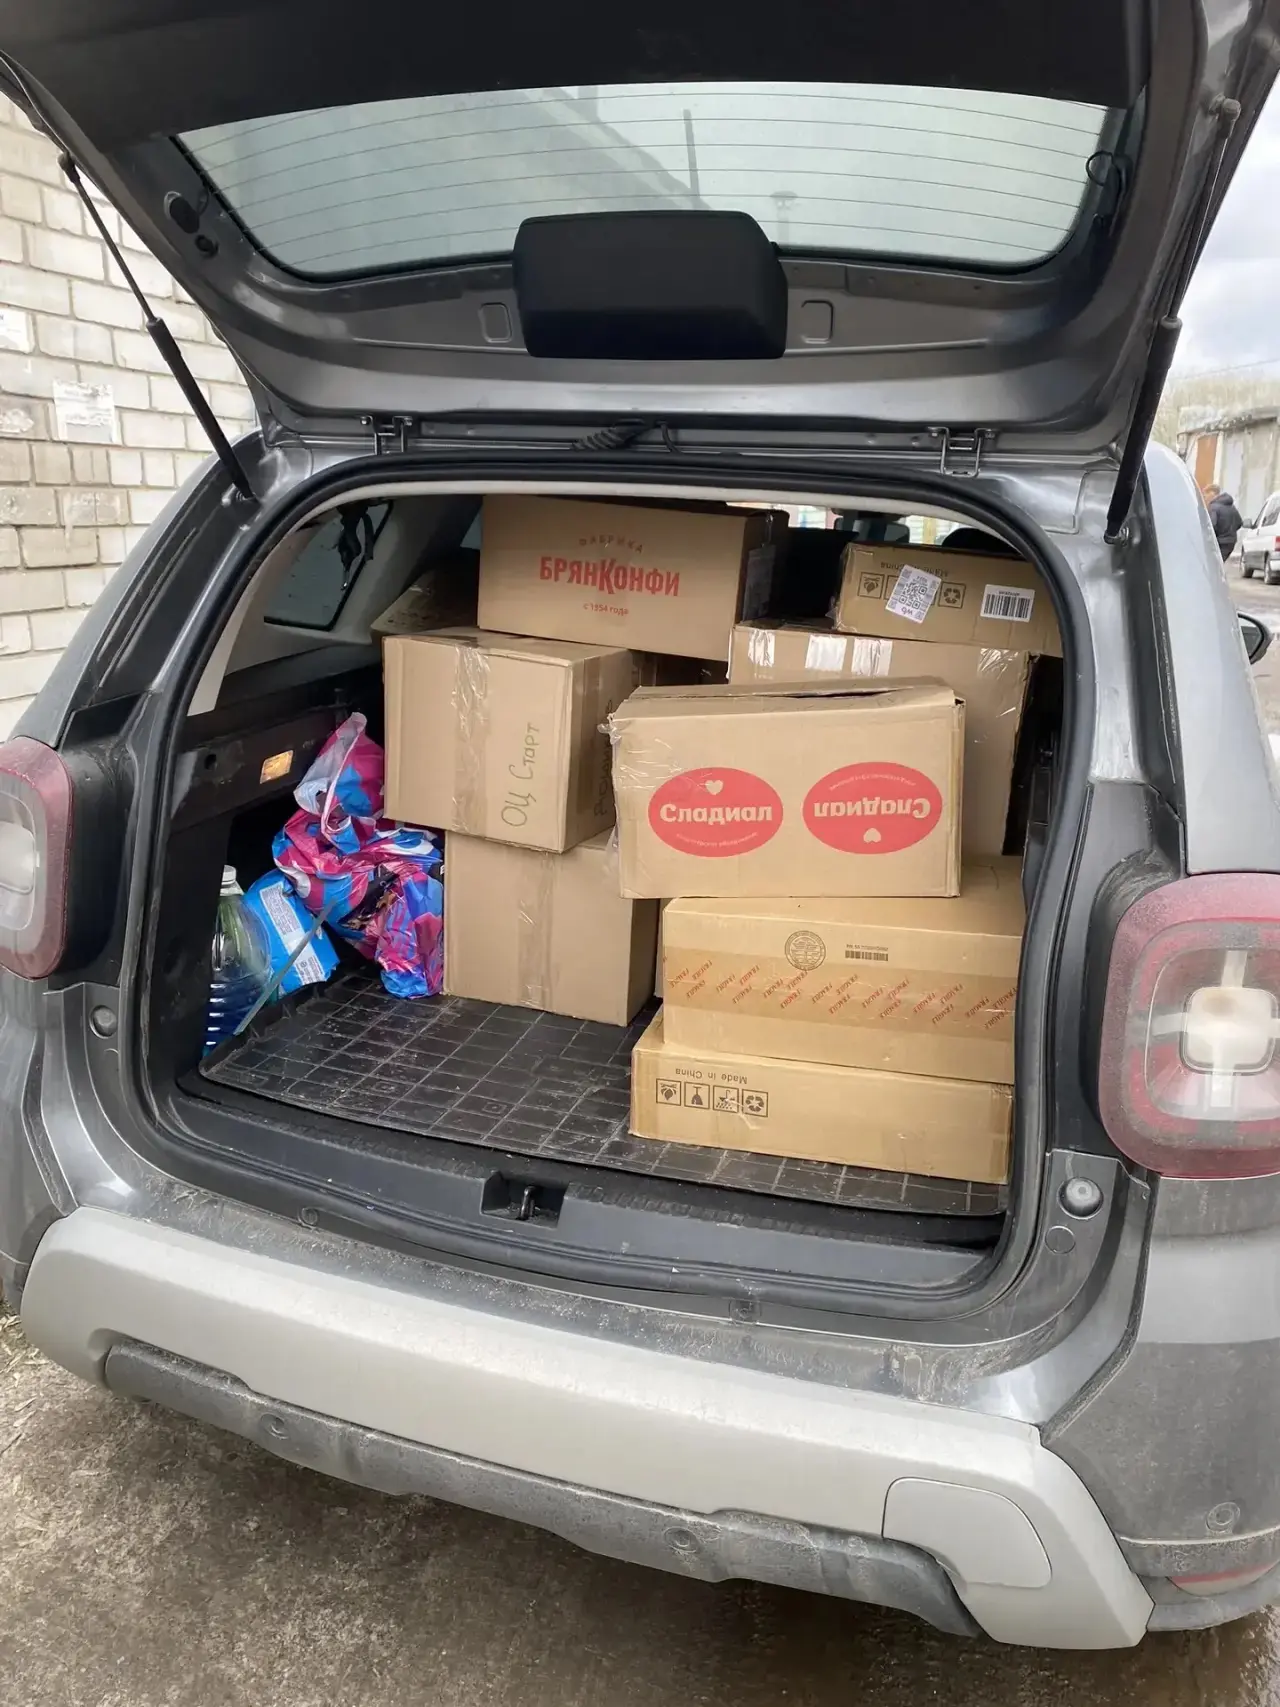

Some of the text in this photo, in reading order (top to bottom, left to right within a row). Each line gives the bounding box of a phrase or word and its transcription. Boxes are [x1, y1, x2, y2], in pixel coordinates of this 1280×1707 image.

[579, 534, 643, 554] ФАБРИКА
[540, 556, 680, 596] БРЯНКОНФИ
[609, 607, 629, 616] года
[900, 606, 914, 617] wb
[660, 803, 773, 825] Сладиал
[813, 798, 931, 818] Сладиал
[675, 1068, 702, 1079] China
[720, 1072, 748, 1084] Made
